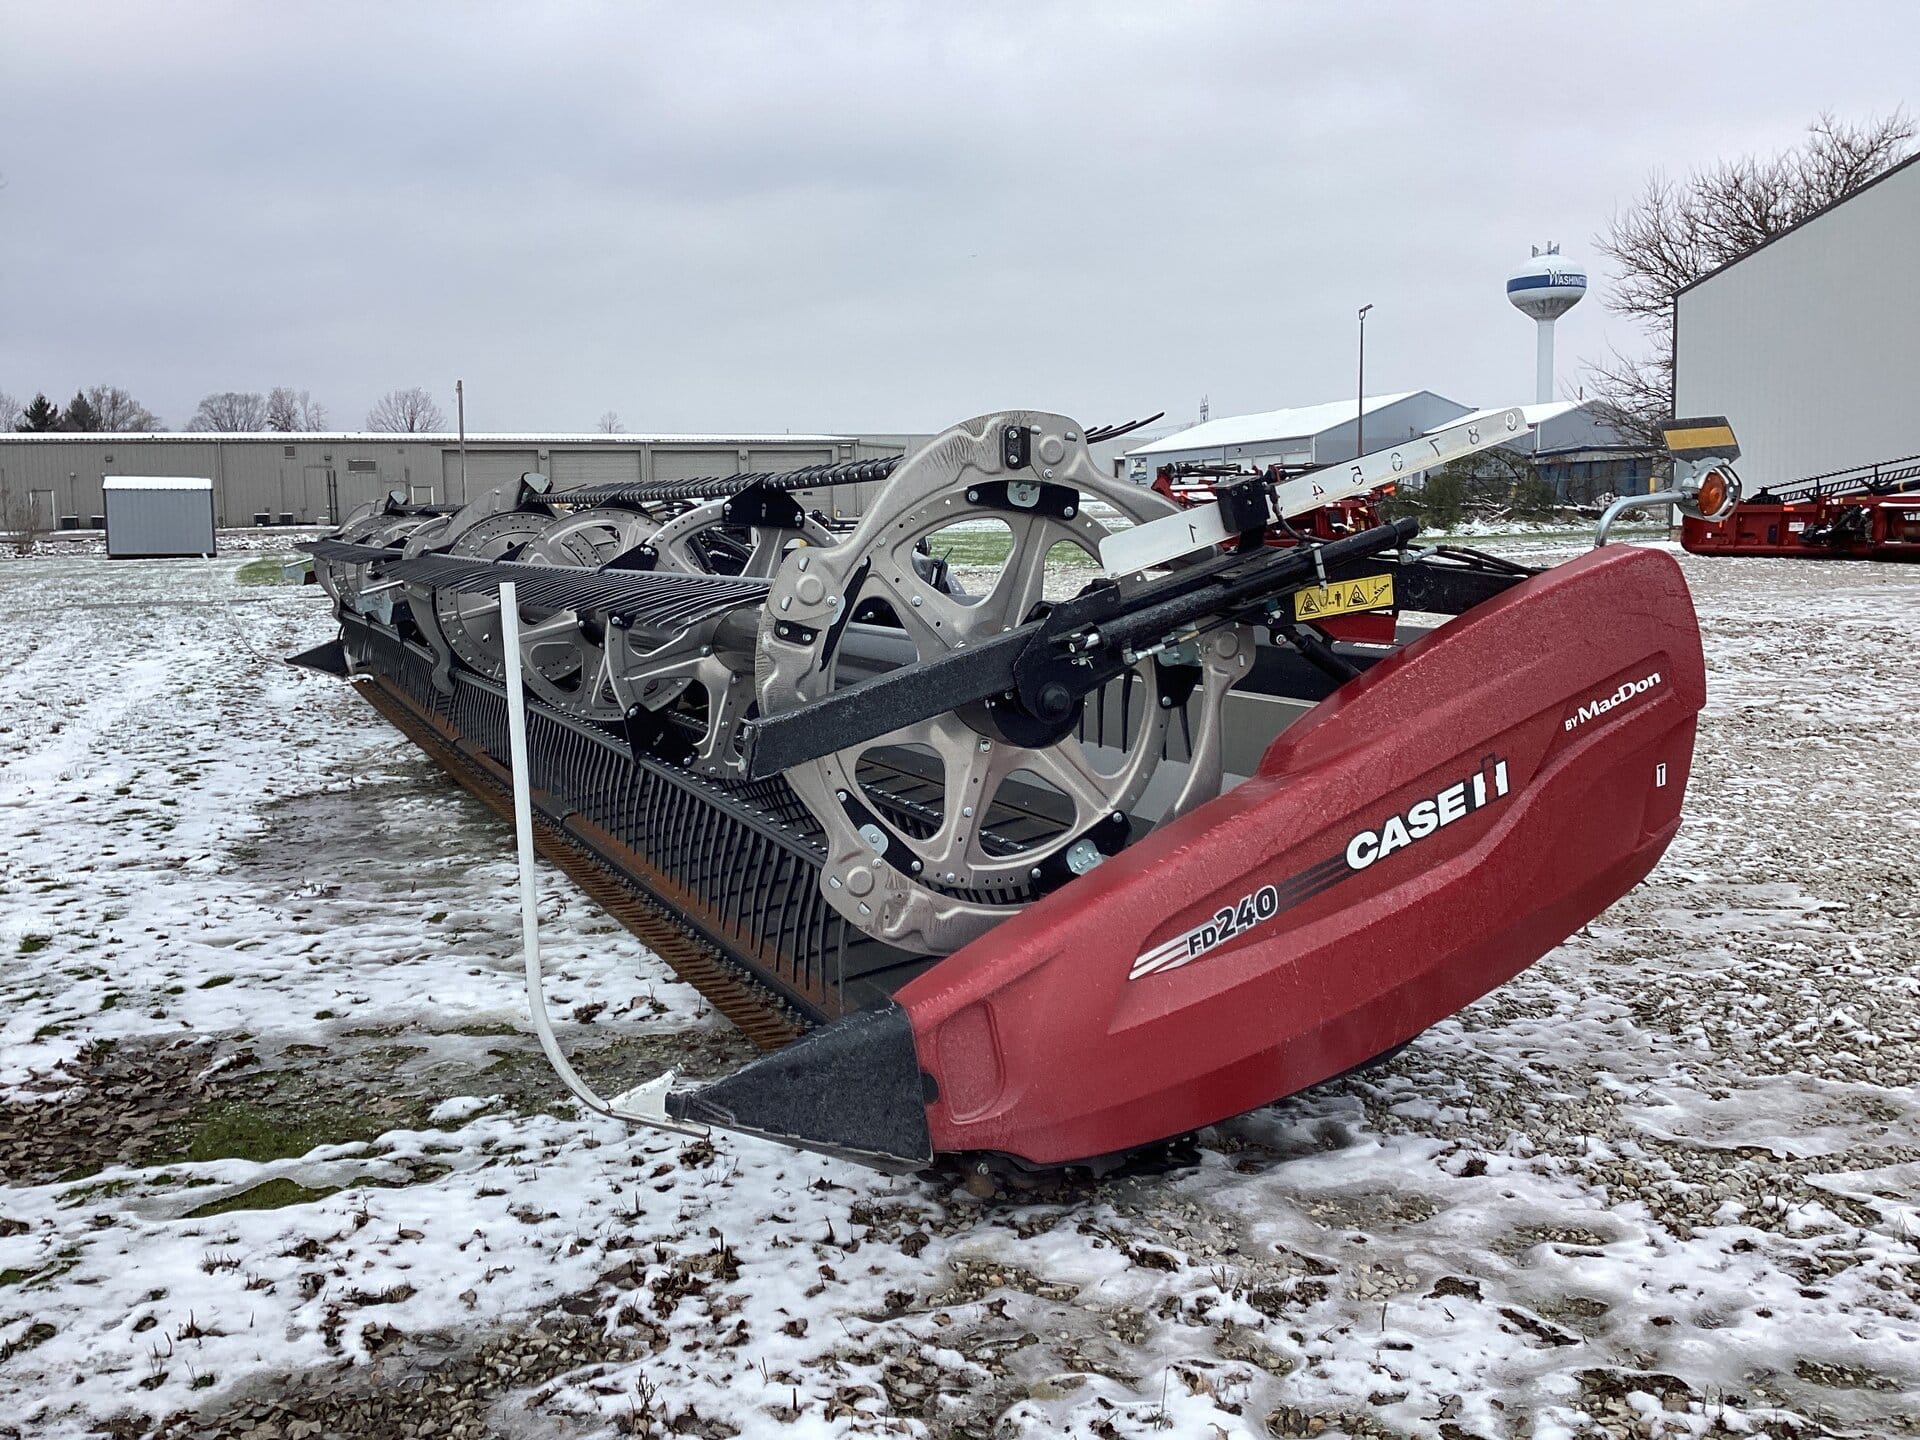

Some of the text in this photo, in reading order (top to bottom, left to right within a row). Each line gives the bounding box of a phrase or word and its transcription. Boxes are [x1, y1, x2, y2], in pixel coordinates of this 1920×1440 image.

[1564, 672, 1661, 731] BY MacDon
[1346, 782, 1467, 870] CASE
[1187, 885, 1277, 958] FD240
